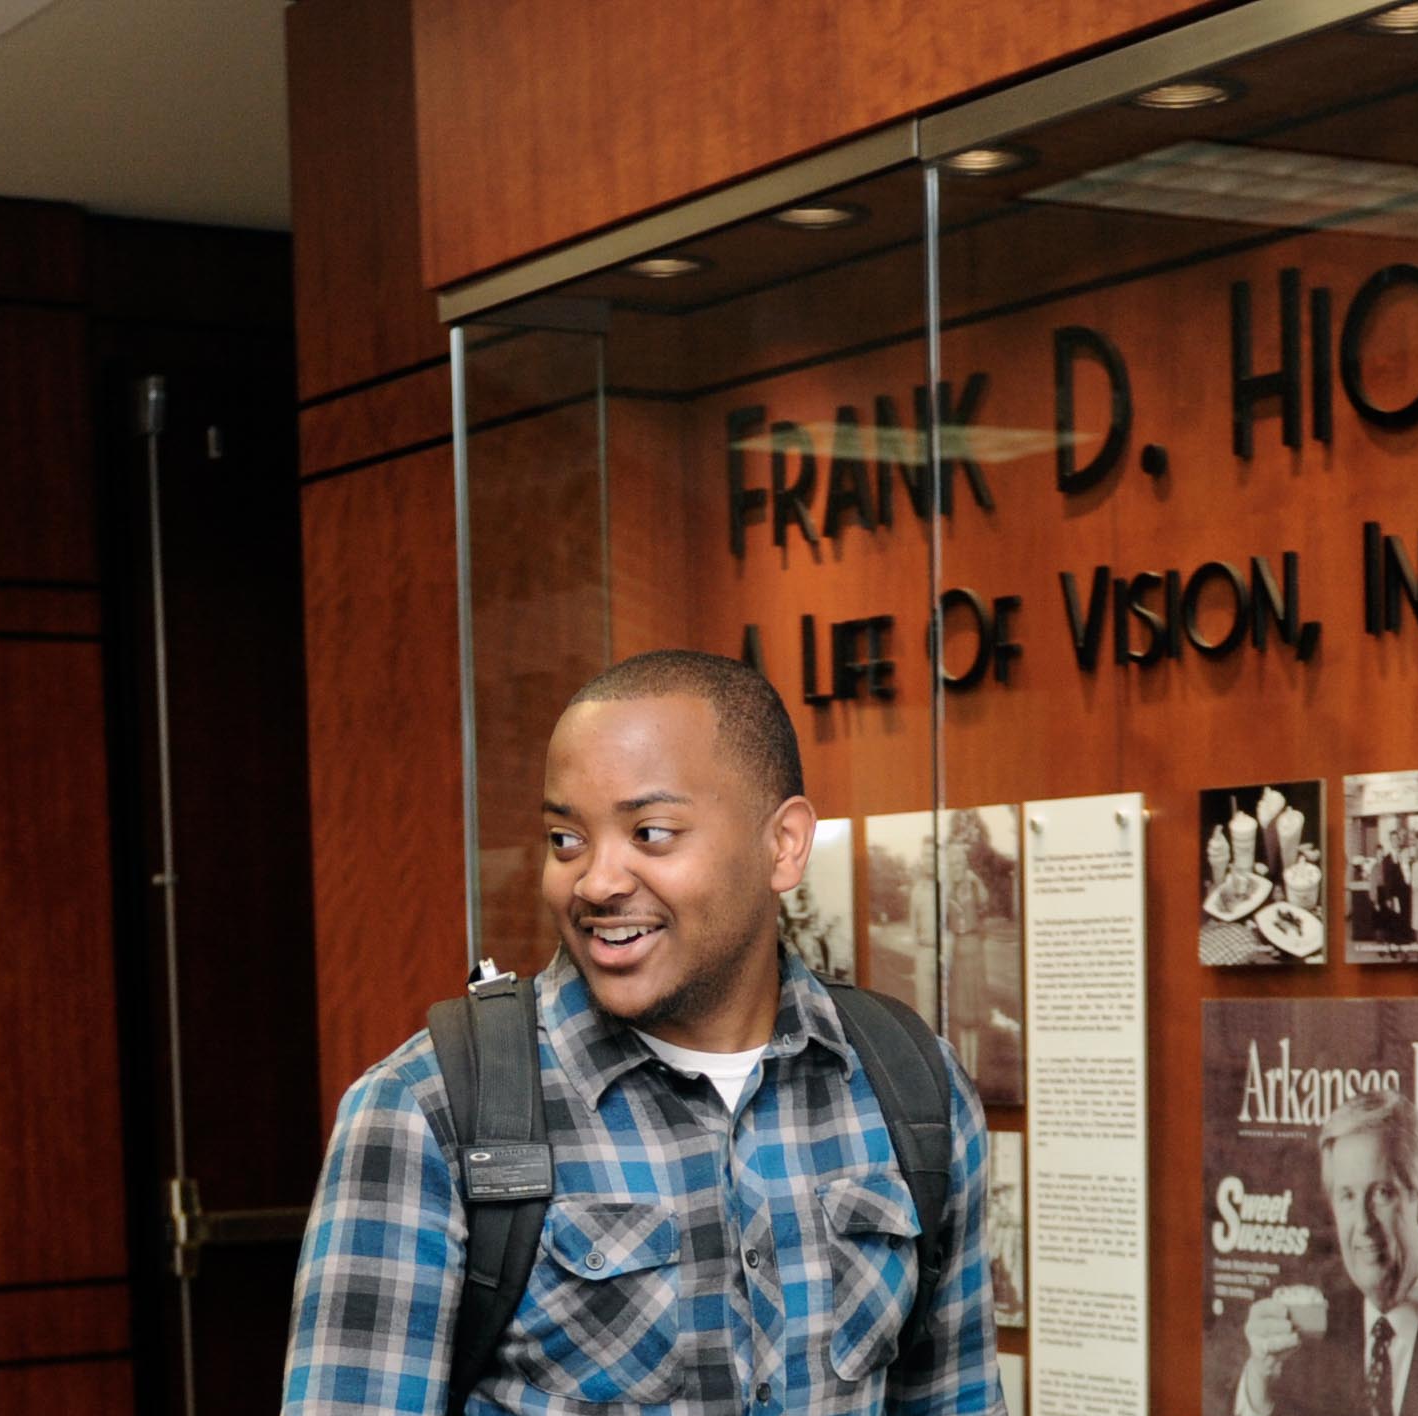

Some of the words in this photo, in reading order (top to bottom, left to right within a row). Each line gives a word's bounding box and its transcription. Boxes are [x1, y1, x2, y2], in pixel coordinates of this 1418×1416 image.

[726, 372, 996, 558] FRANK
[1054, 326, 1168, 493] D.
[927, 587, 1023, 690] OF
[1059, 550, 1321, 672] VISION,
